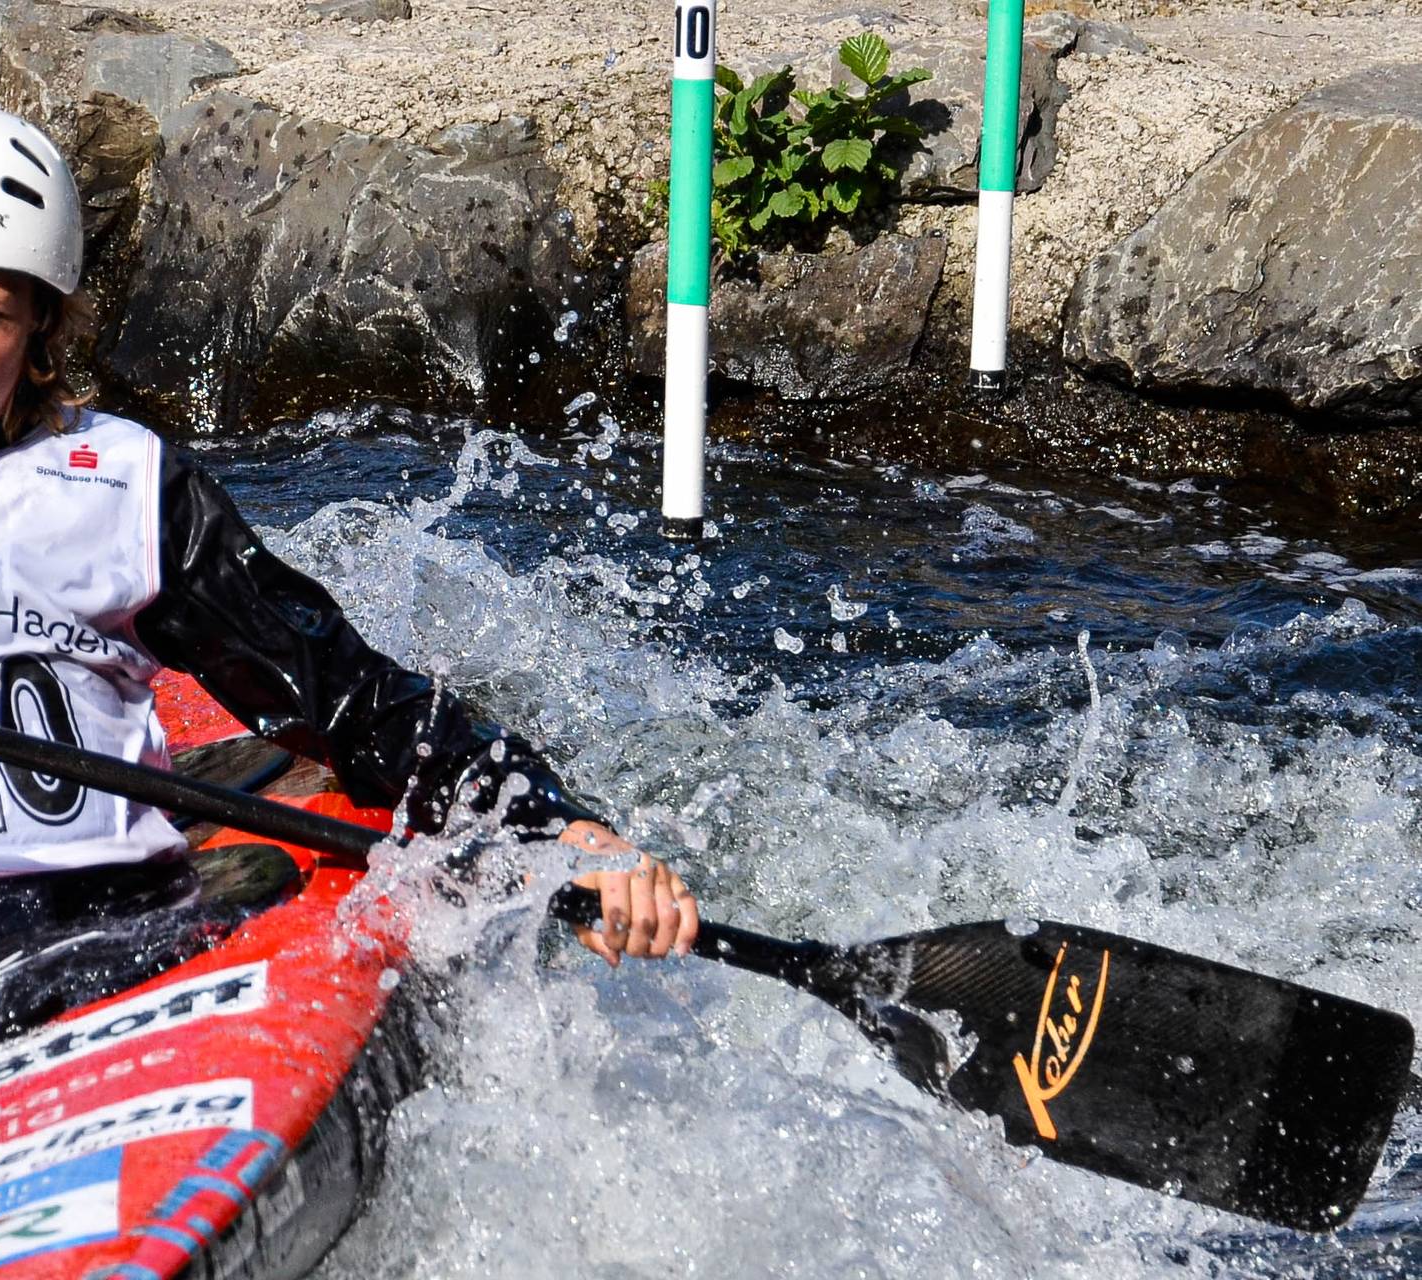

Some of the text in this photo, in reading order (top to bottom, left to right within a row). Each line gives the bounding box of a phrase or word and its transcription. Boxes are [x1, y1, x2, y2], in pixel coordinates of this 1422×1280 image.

[675, 5, 710, 59] 10
[36, 465, 128, 490] Sparkasse Hagen
